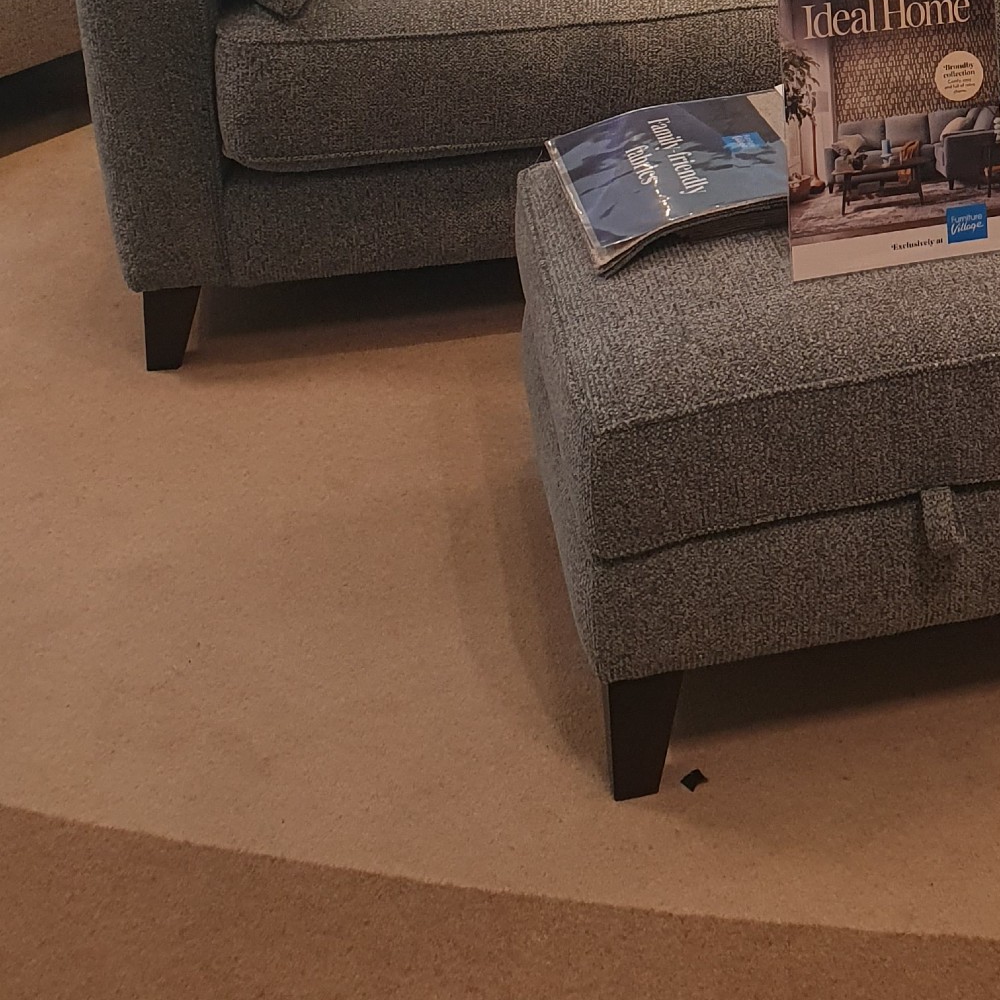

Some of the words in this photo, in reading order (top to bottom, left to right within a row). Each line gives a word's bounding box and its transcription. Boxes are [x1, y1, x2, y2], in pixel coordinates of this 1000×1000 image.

[943, 69, 976, 78] collection
[648, 117, 709, 195] Family-friendly
[625, 144, 660, 186] fabrics
[951, 213, 983, 224] Furniture
[950, 221, 984, 236] Village
[891, 239, 934, 251] Exclusively
